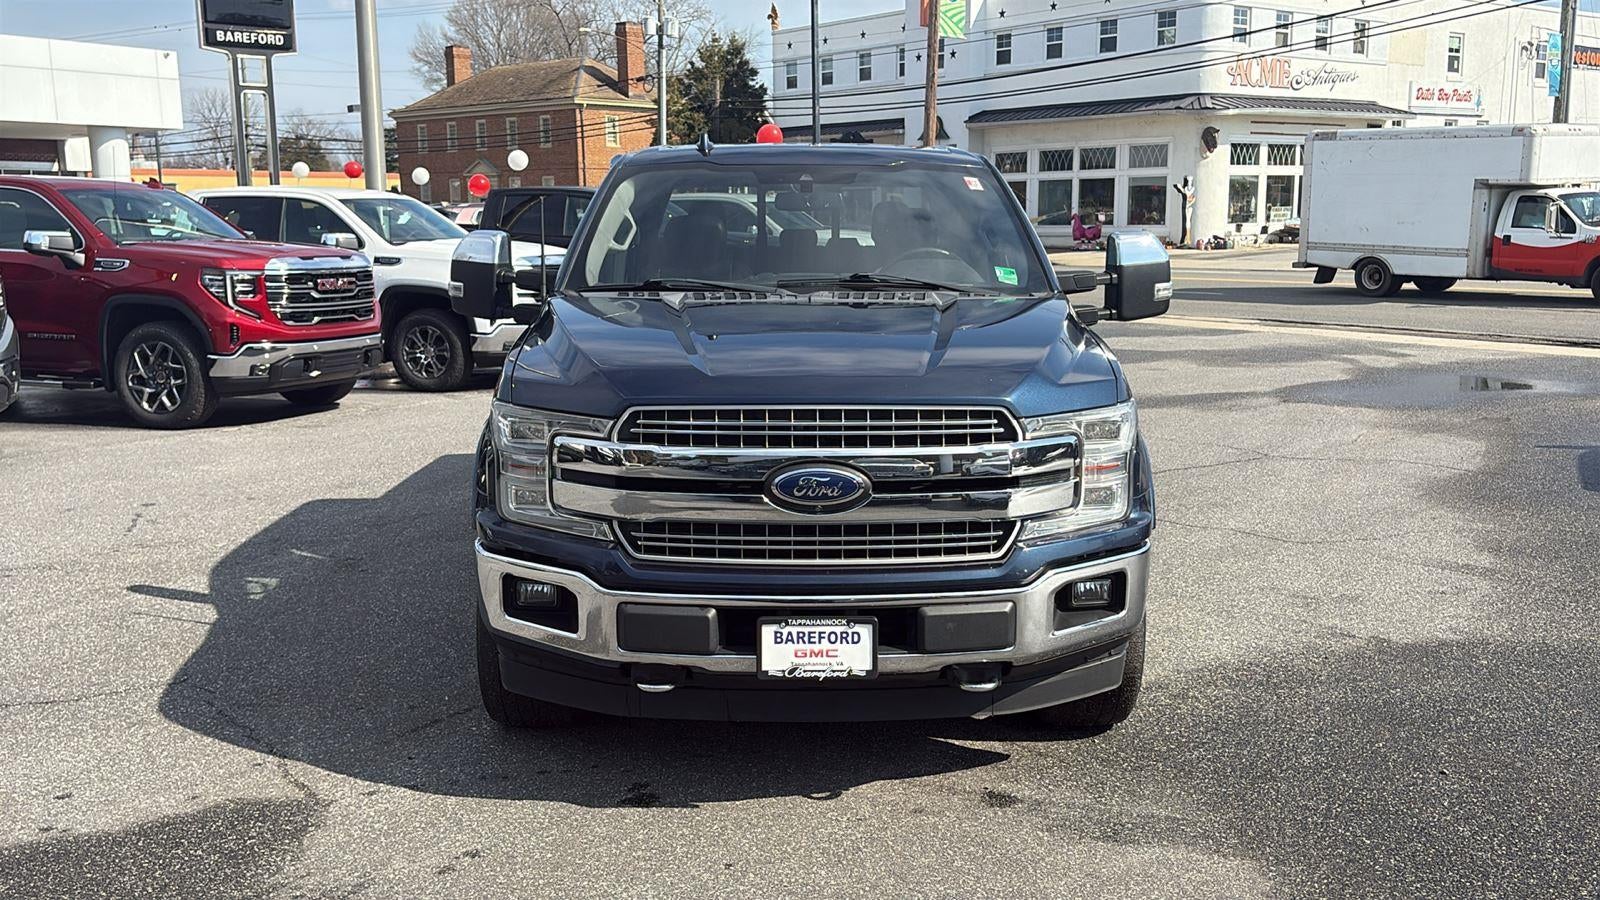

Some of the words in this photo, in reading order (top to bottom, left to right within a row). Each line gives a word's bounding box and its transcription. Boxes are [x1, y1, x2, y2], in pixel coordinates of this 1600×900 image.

[216, 30, 284, 46] BAREFORD
[1226, 56, 1292, 89] ACME
[1306, 62, 1359, 92] Antiques
[1416, 87, 1435, 101] Dutch
[1437, 88, 1451, 104] Boy
[1452, 88, 1473, 103] Paints
[793, 476, 842, 497] Ford
[774, 631, 861, 644] BAREFORD
[794, 648, 839, 658] GMC
[785, 666, 853, 681] Bareford
